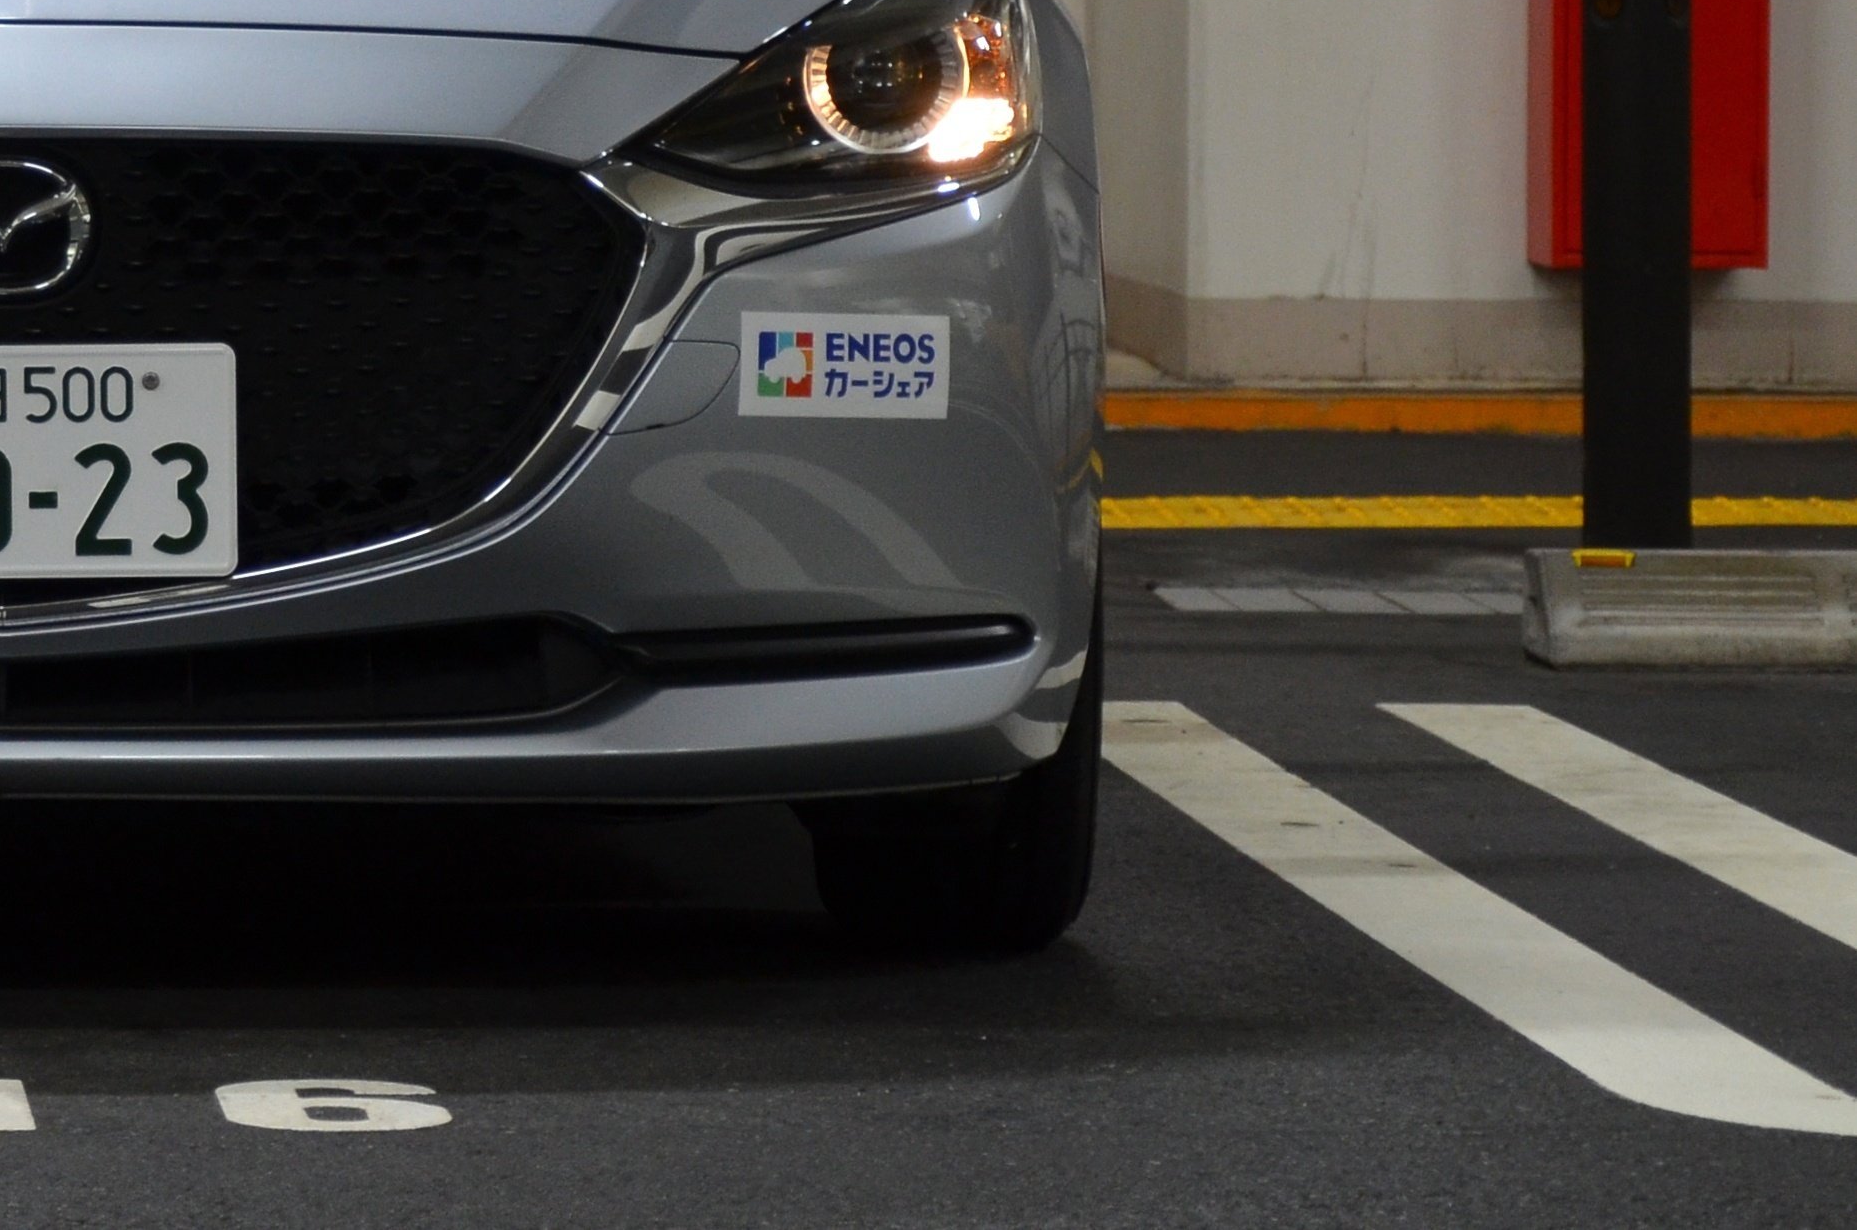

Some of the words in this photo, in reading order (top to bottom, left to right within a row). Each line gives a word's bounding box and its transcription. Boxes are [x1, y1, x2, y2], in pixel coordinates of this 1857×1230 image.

[826, 333, 935, 364] ENEOS
[824, 368, 934, 398] カーシェア
